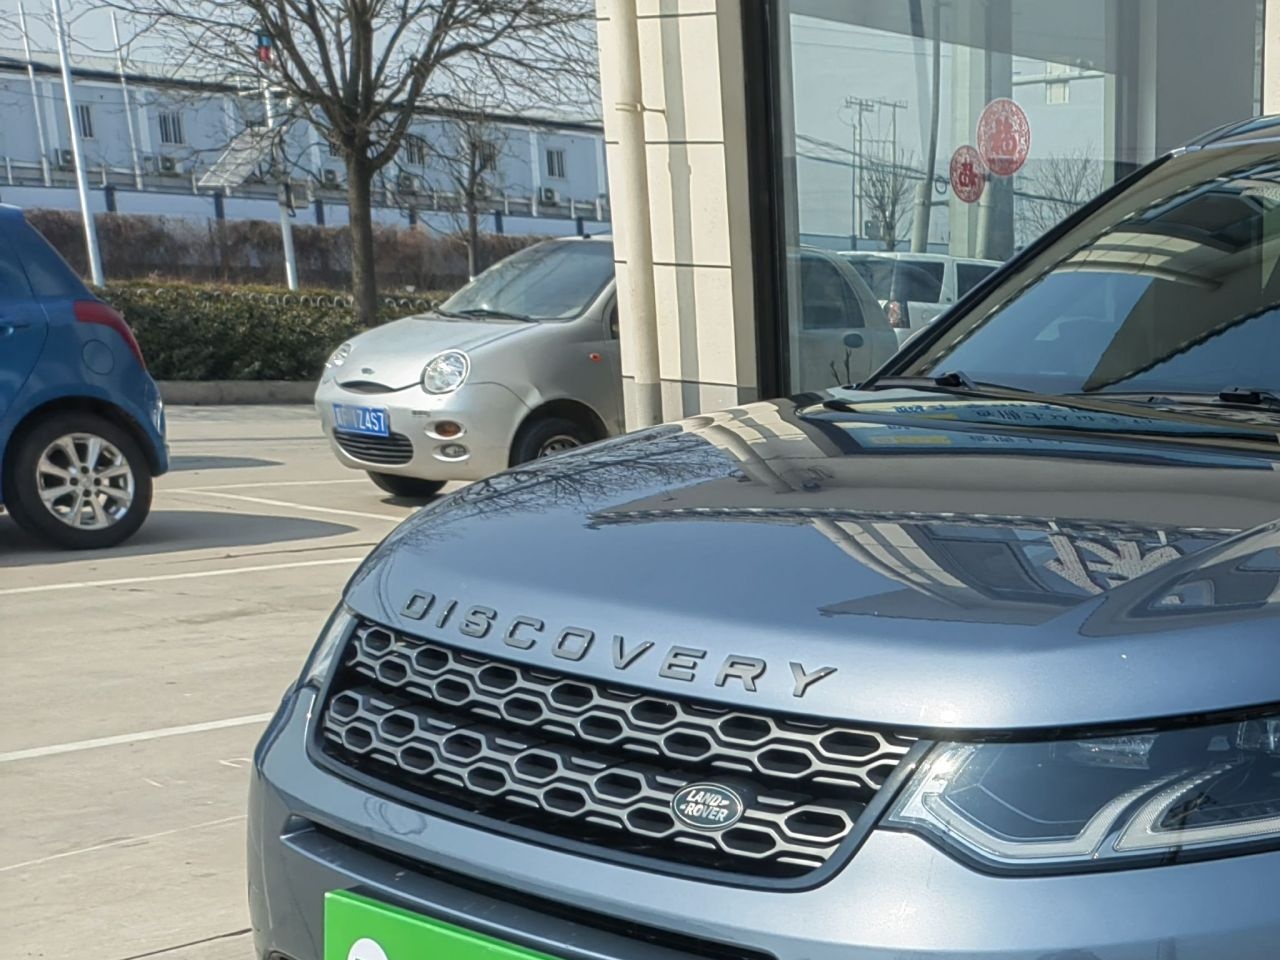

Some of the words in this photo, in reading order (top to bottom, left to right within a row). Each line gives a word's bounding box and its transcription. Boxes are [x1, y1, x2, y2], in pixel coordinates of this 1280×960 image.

[400, 589, 837, 698] DISCOVERY
[686, 789, 722, 807] LAND
[684, 802, 729, 822] ROVER
